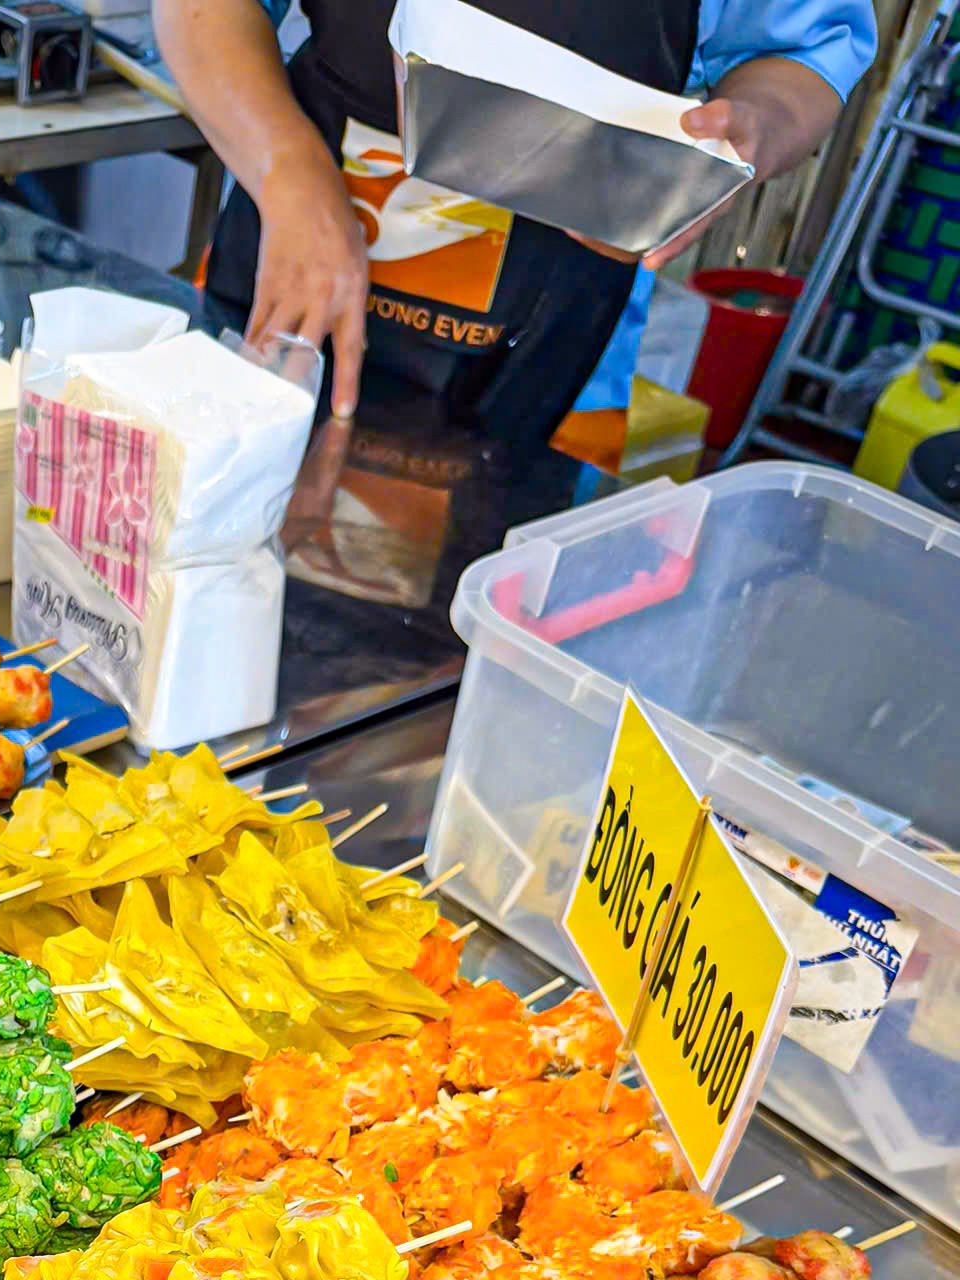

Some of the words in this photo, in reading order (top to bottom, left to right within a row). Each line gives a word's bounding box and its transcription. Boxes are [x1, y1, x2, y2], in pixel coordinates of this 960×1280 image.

[584, 785, 657, 951] ĐỒNG
[639, 883, 702, 1019] GIÁ
[672, 945, 756, 1127] 30.000
